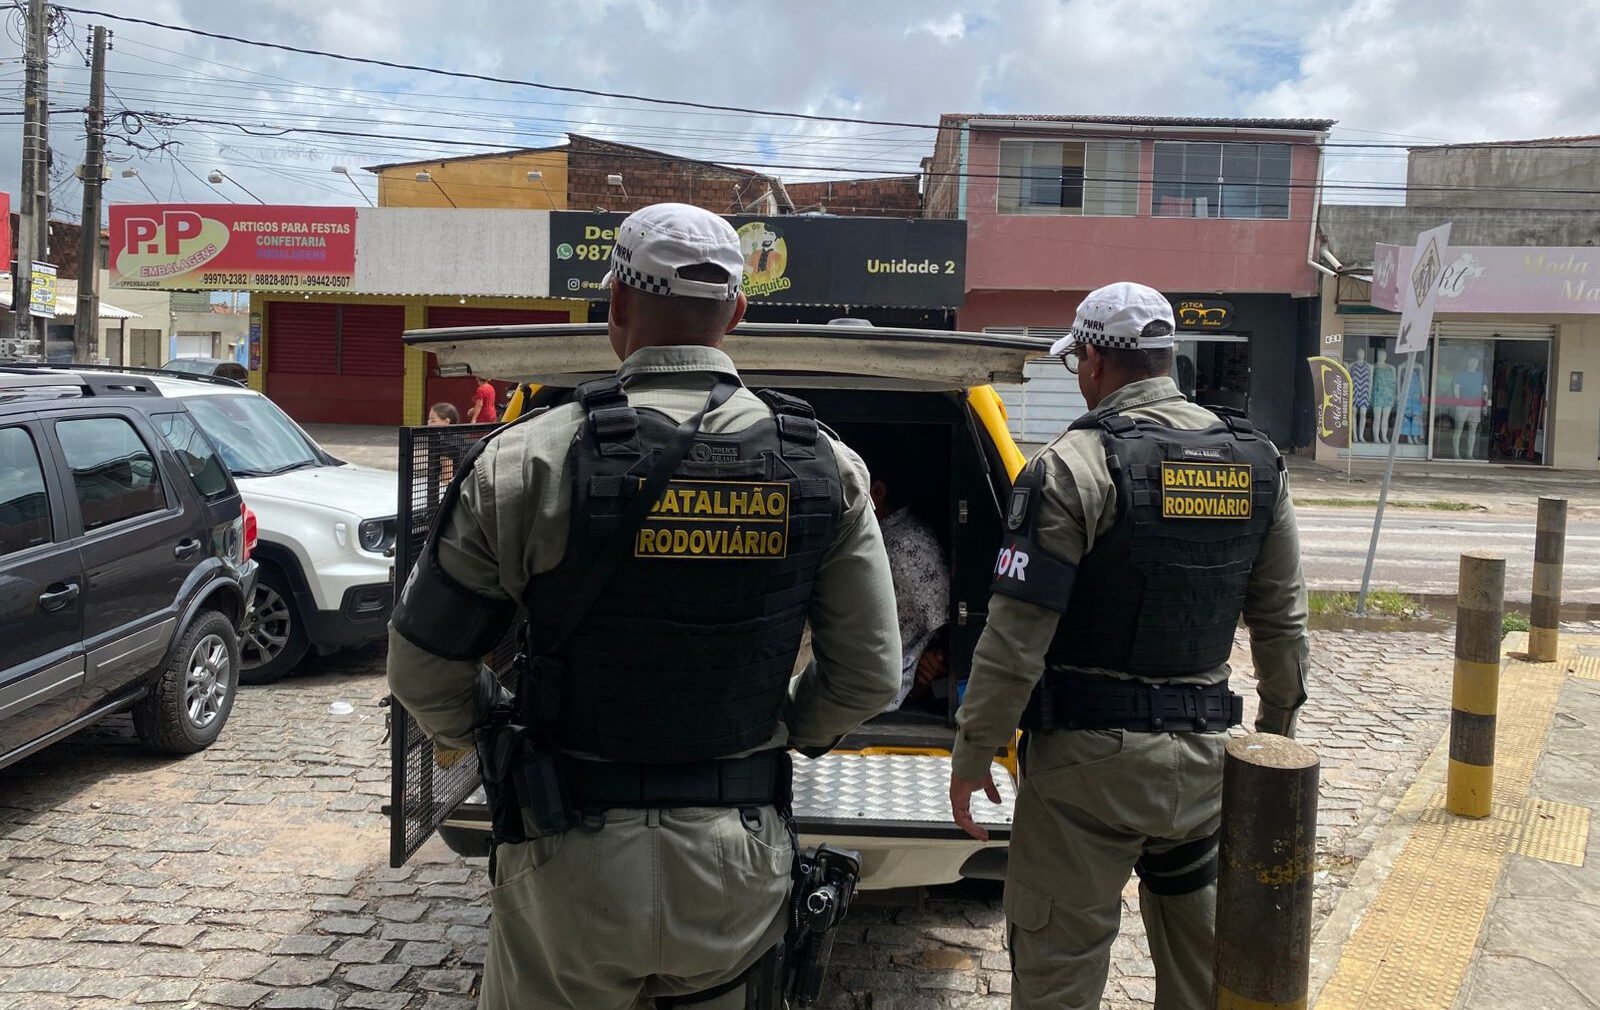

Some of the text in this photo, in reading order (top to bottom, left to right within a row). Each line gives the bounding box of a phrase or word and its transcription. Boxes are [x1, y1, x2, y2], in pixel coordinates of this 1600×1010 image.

[232, 221, 351, 234] ARTIGOS PARA FESTAS
[256, 235, 327, 247] CONFEITARIA
[141, 243, 216, 277] EMBALAGENS
[867, 259, 955, 274] Unidade 2
[203, 273, 351, 287] 99970-2382 98828-8073 99442-0507
[1083, 319, 1105, 332] PMRN
[1164, 467, 1250, 488] BATALHÃO
[651, 486, 786, 516] ATALHÃO
[1165, 493, 1249, 516] RODOVIÁRIO
[639, 525, 784, 554] RODOVIÁRIO
